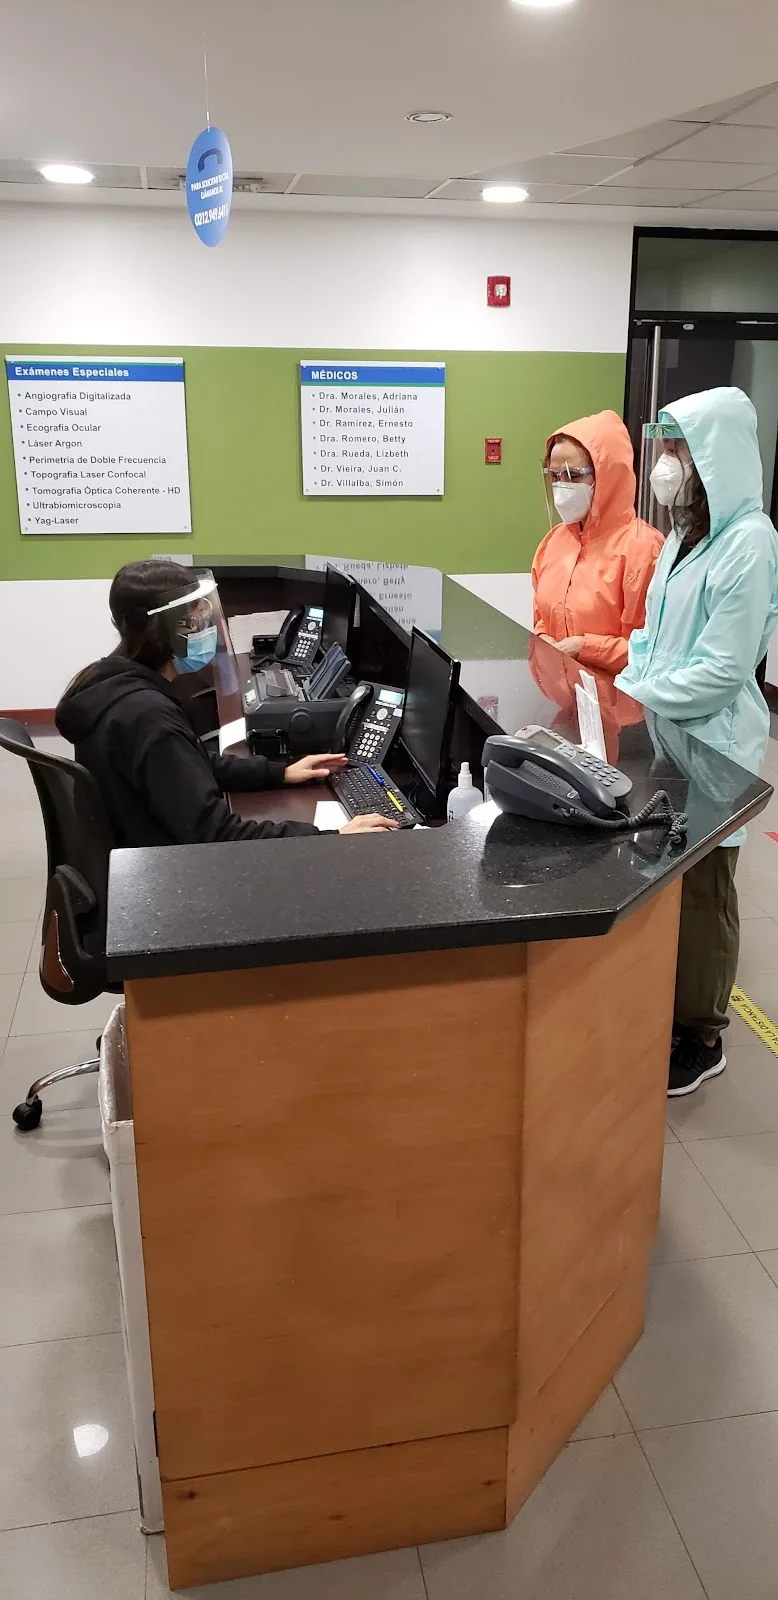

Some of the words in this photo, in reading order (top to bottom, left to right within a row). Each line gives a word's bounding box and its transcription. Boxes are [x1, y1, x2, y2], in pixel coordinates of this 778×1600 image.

[15, 366, 69, 376] Exámenes
[72, 367, 129, 378] Especiales
[311, 370, 358, 380] MÉDICOS
[80, 392, 131, 401] Digitalizada
[341, 392, 380, 401] Morales,
[382, 392, 418, 400] Adriana
[25, 408, 57, 417] Campo
[335, 406, 374, 414] Morales,
[71, 424, 102, 432] Ocular
[341, 435, 379, 443] Romero,
[382, 435, 406, 444] Betty
[55, 440, 83, 449] Argon
[342, 450, 373, 458] Rueda,
[336, 465, 365, 474] Vieira,
[84, 485, 112, 496] Óptica
[34, 517, 79, 526] Yag-Laser
